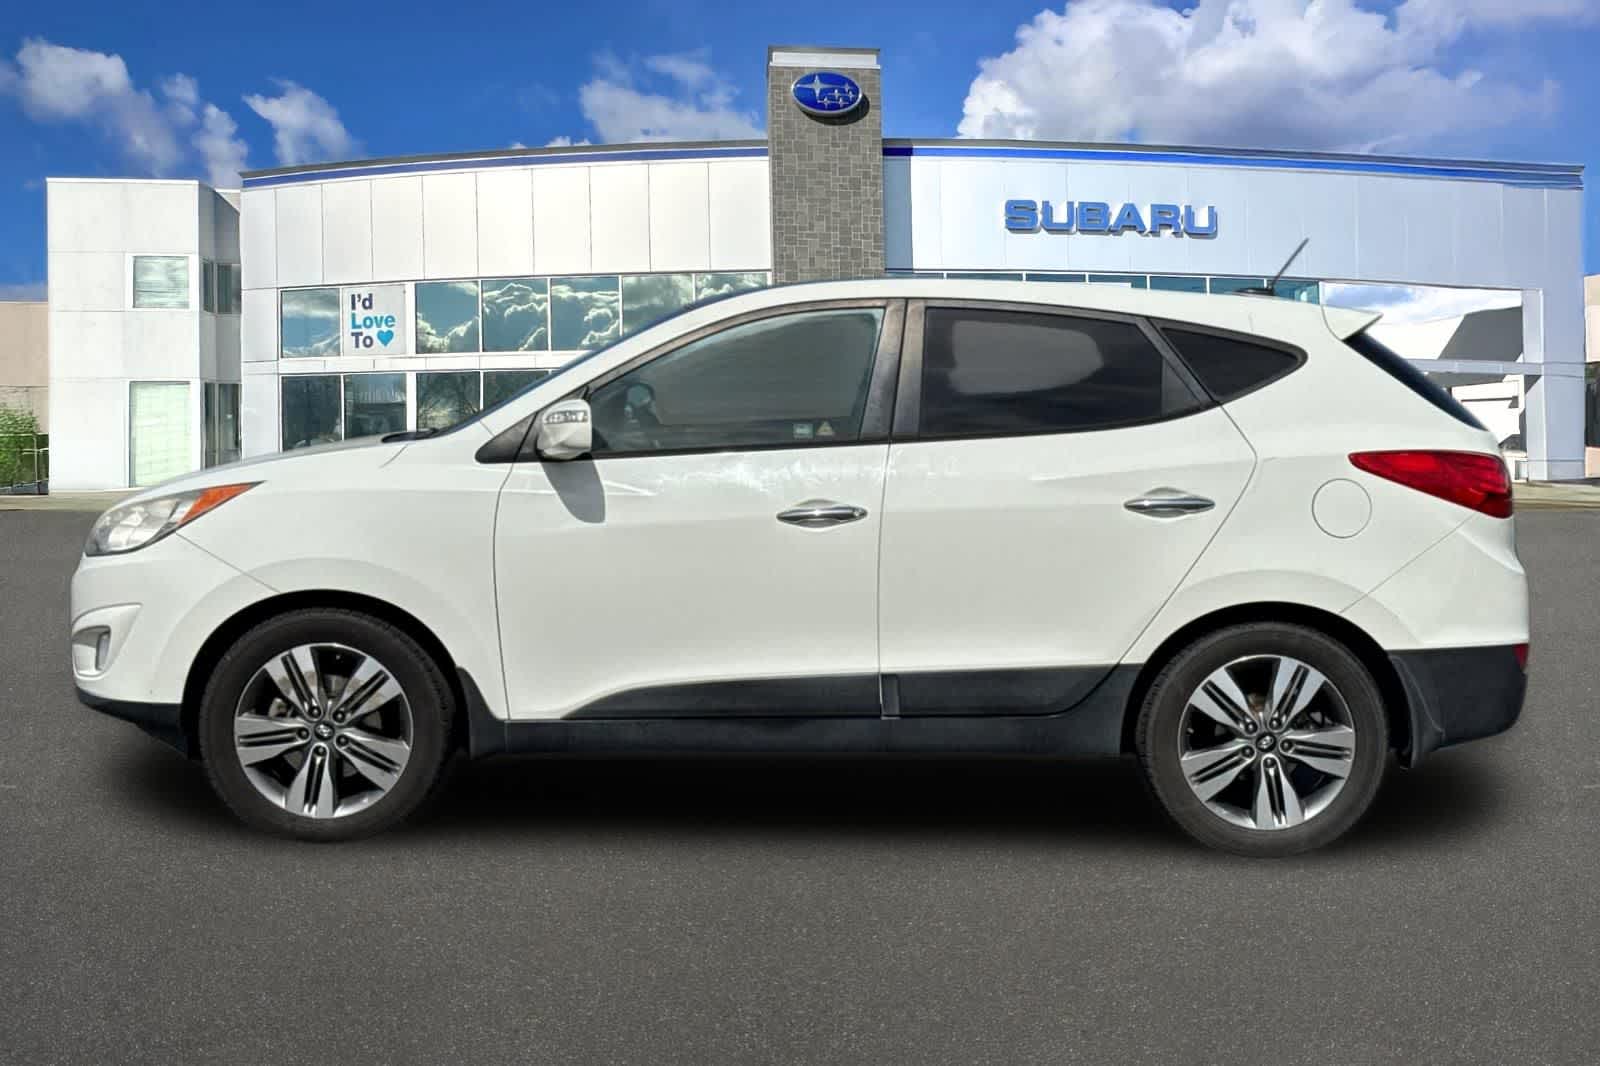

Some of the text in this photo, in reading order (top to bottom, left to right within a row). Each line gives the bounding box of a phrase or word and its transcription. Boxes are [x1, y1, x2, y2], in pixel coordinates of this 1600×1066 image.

[1005, 199, 1217, 239] SUBARU
[351, 293, 373, 310] I'd
[351, 312, 396, 330] Love
[351, 331, 374, 349] To
